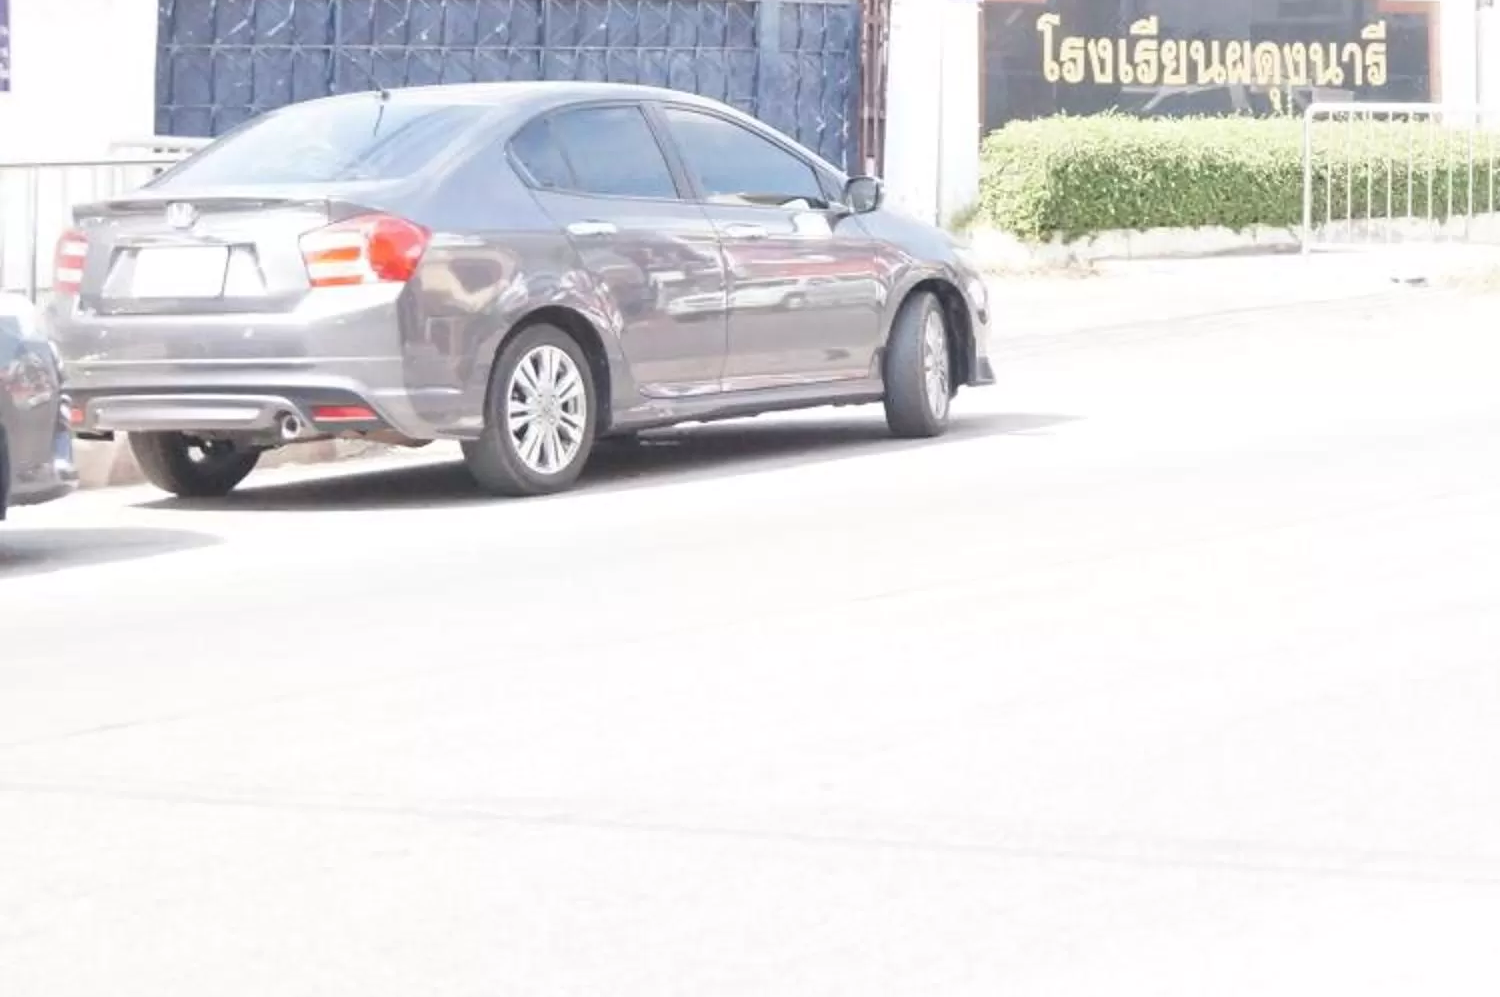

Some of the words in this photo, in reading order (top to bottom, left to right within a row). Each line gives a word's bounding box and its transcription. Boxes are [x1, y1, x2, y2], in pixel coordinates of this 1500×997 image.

[1037, 13, 1386, 111] โรงเรียนผดุงนารี
